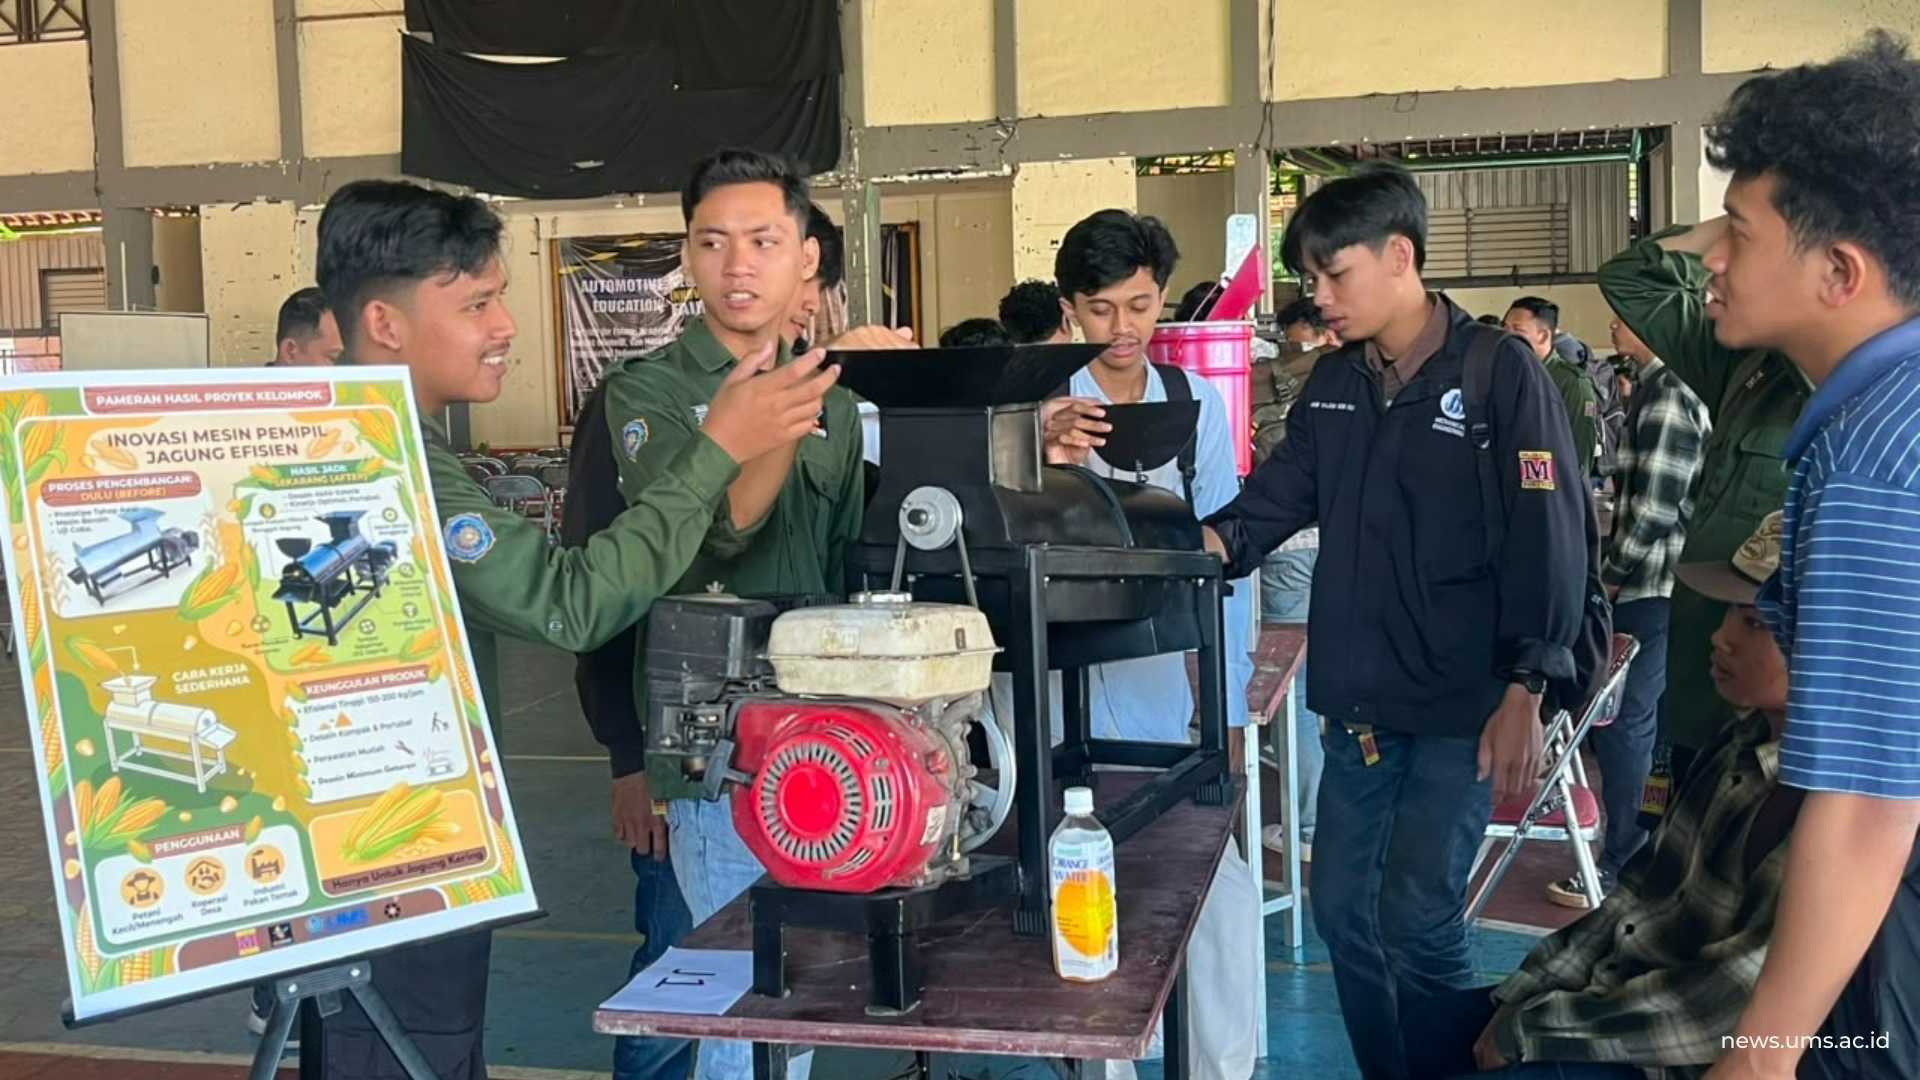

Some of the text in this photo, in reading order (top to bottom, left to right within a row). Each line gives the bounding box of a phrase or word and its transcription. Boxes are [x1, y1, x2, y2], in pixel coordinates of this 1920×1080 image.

[581, 278, 662, 294] AUTOMOTIVE
[593, 300, 665, 313] EDUCATION
[96, 390, 322, 406] PAMERAN HASIL PROYEK KELOMPOK
[108, 425, 328, 448] INOVASI MESIN PEMIPIL
[146, 443, 299, 465] JAGUNG EFISIEN
[290, 465, 318, 477] HASIL
[1523, 461, 1548, 480] M
[48, 480, 94, 493] PROSES
[273, 473, 368, 488] SEKARANG (AFTER)
[81, 487, 167, 501] DULU (BEFORE)
[172, 663, 248, 683] CARA KERJA
[175, 676, 250, 694] SEDERHANA
[306, 669, 426, 695] KEUNGGULAN PRODUK
[309, 731, 337, 743] Desain
[313, 744, 385, 763] Perawatan Mudah
[318, 774, 344, 785] Desain
[346, 768, 383, 780] Minimum
[154, 828, 241, 853] PENGGUNAAN
[332, 851, 484, 889] Hanya Untuk Jagung Kering
[1054, 858, 1089, 870] ORANGE
[1054, 871, 1089, 882] WATER
[191, 894, 228, 908] Koperasi
[243, 889, 298, 907] Pakan Ternak
[132, 908, 161, 920] Petani
[201, 906, 222, 916] Desa
